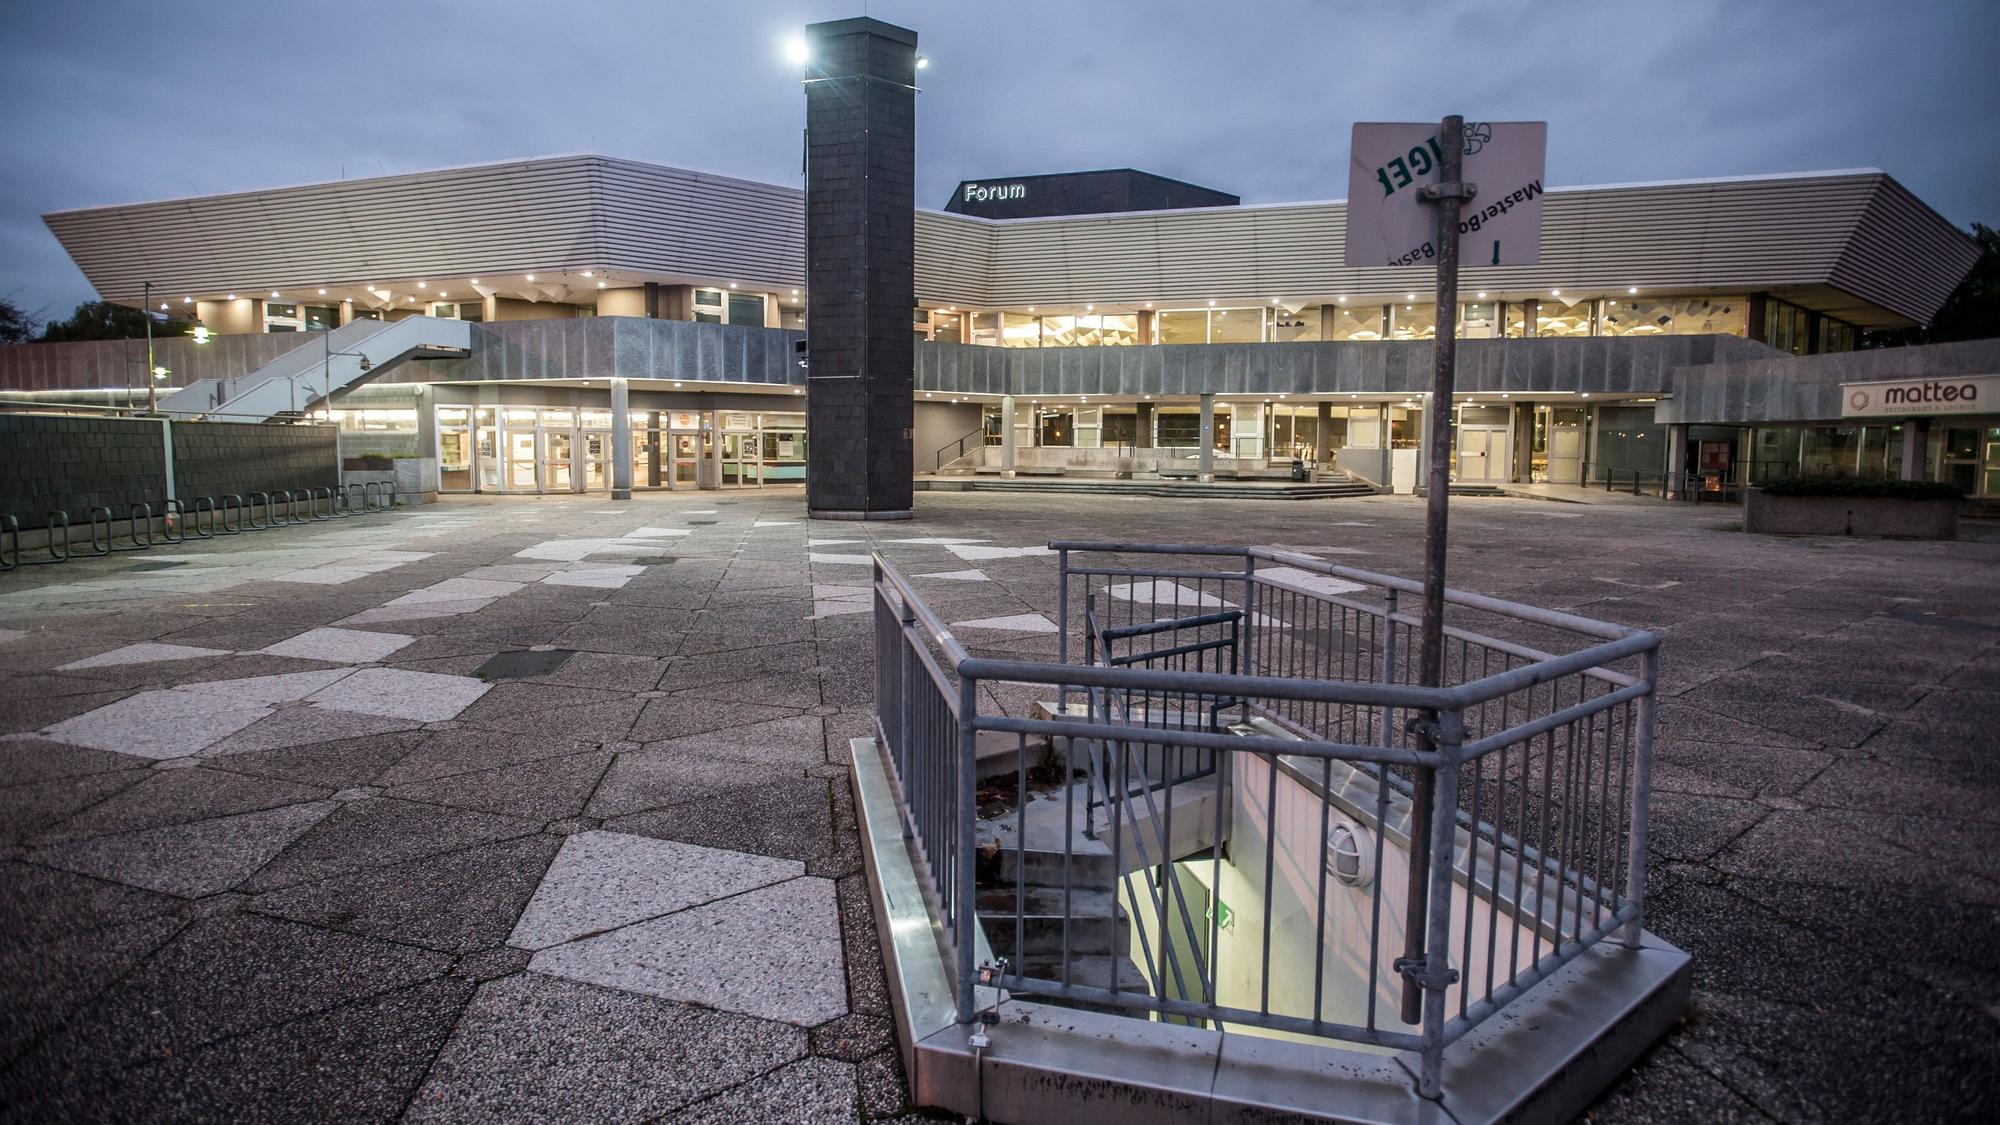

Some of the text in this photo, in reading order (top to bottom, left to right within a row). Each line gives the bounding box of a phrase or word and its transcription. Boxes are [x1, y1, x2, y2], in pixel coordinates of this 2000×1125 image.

[964, 183, 1025, 201] Forum
[1459, 180, 1543, 234] MasterBo
[1885, 382, 1977, 404] mattea
